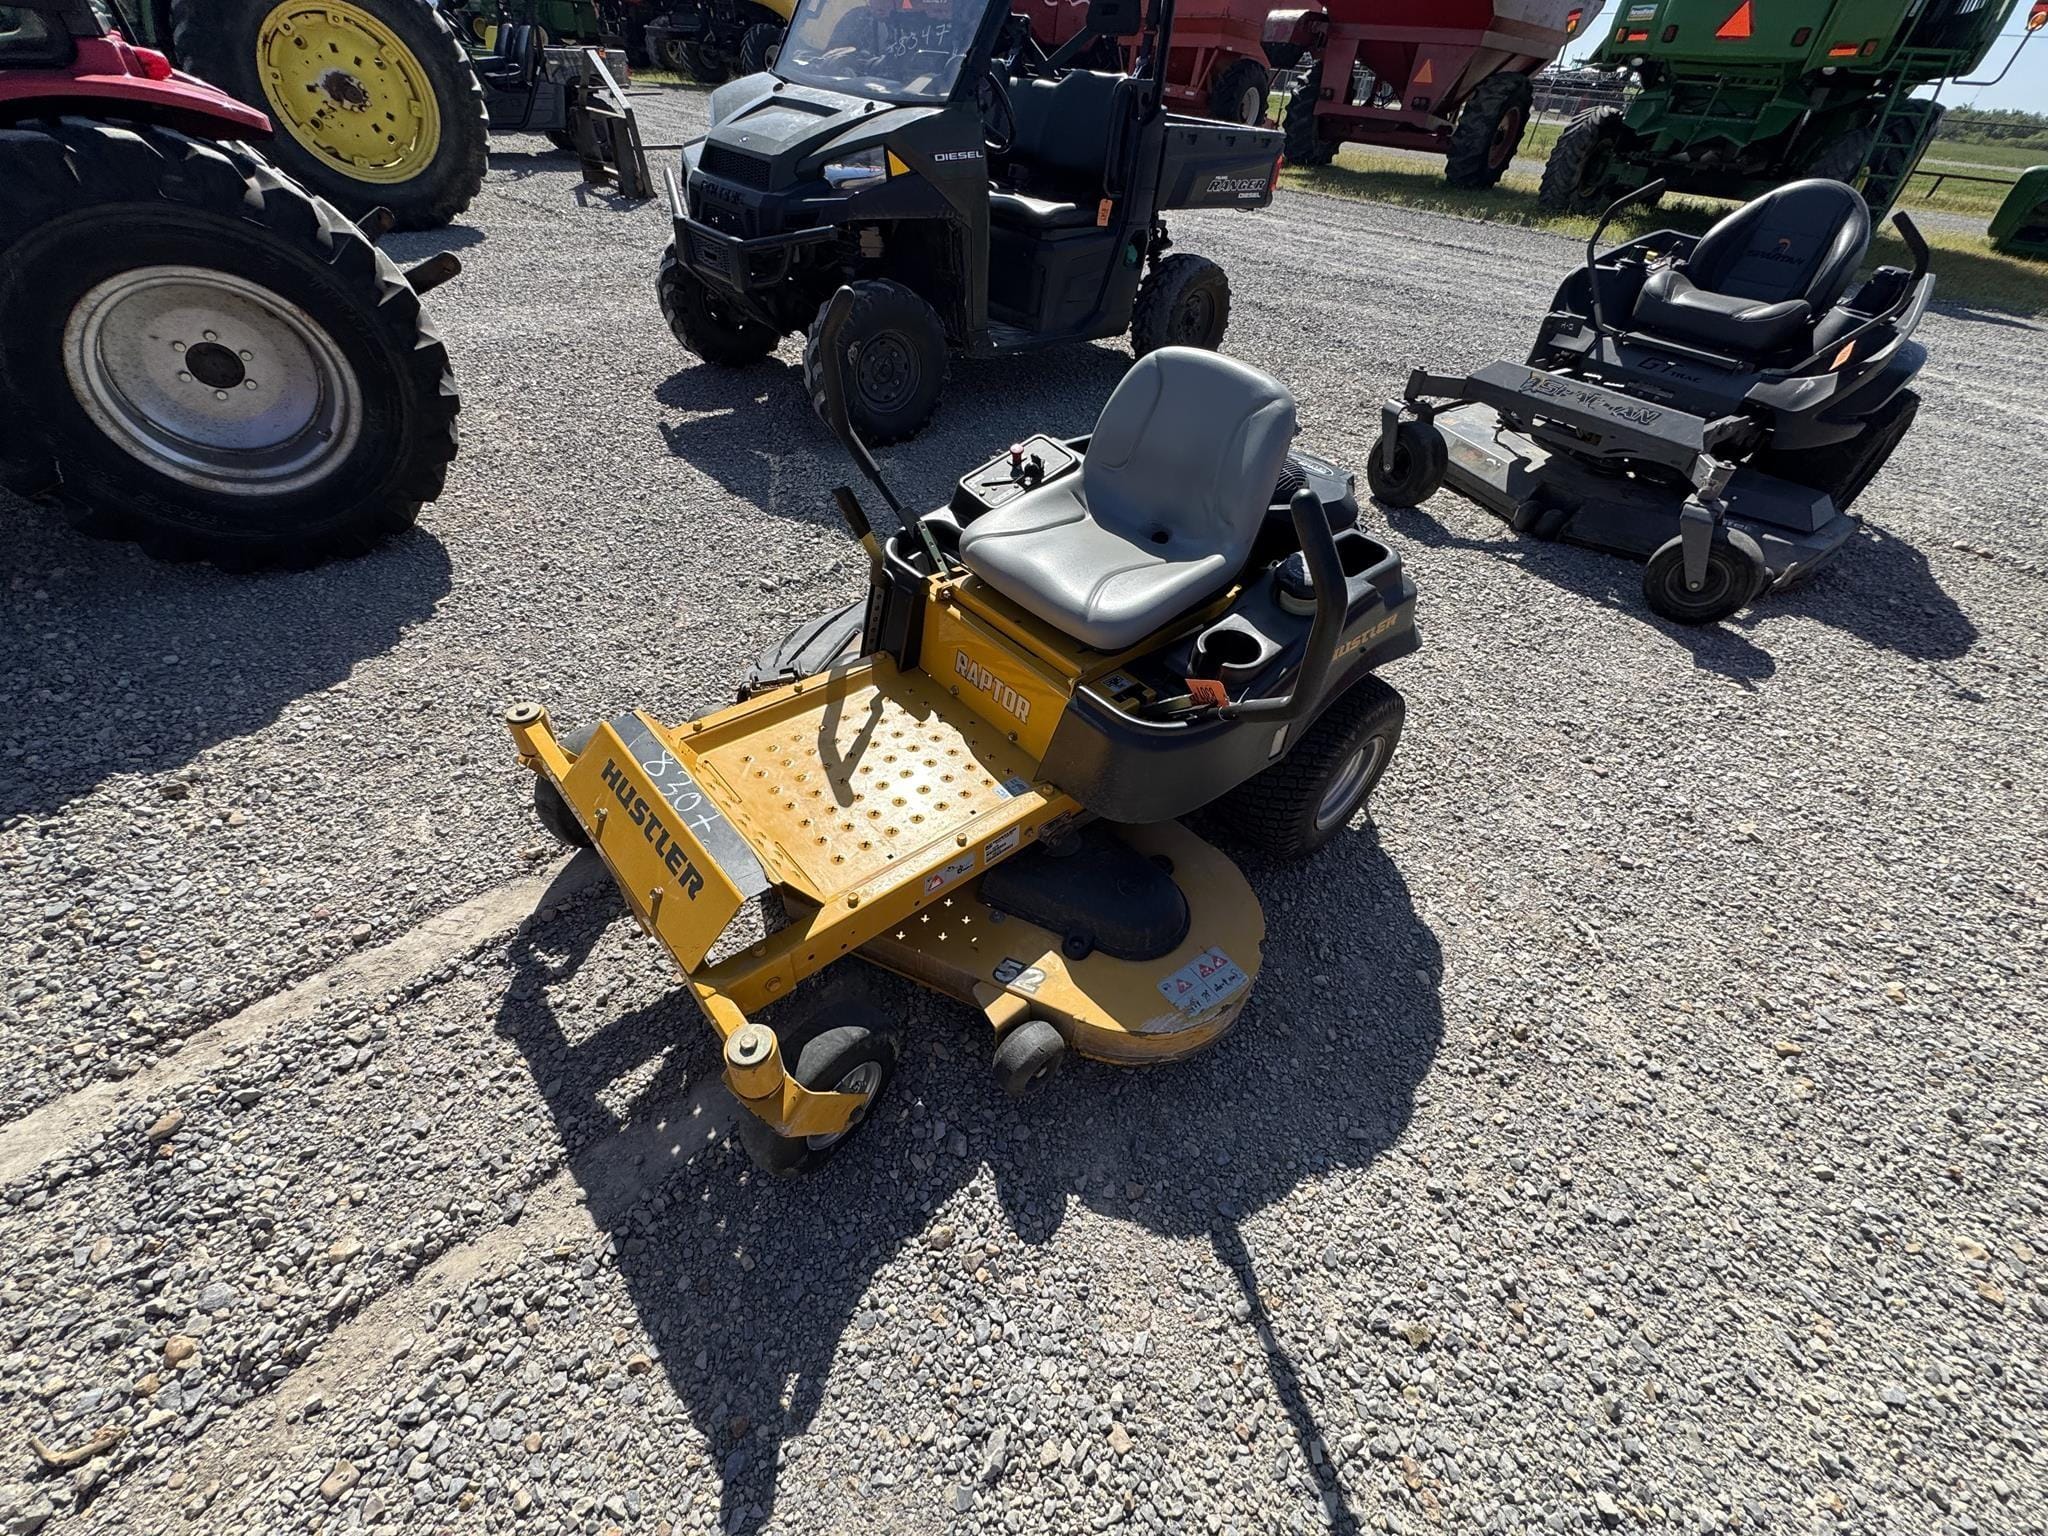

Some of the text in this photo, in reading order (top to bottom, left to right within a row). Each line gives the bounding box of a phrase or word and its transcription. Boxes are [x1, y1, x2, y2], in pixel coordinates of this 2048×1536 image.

[934, 150, 984, 162] DIESEL
[1206, 179, 1266, 192] RANGER
[955, 648, 1031, 725] RAPTOR
[600, 758, 705, 901] HUSTLER
[993, 957, 1046, 994] 52
